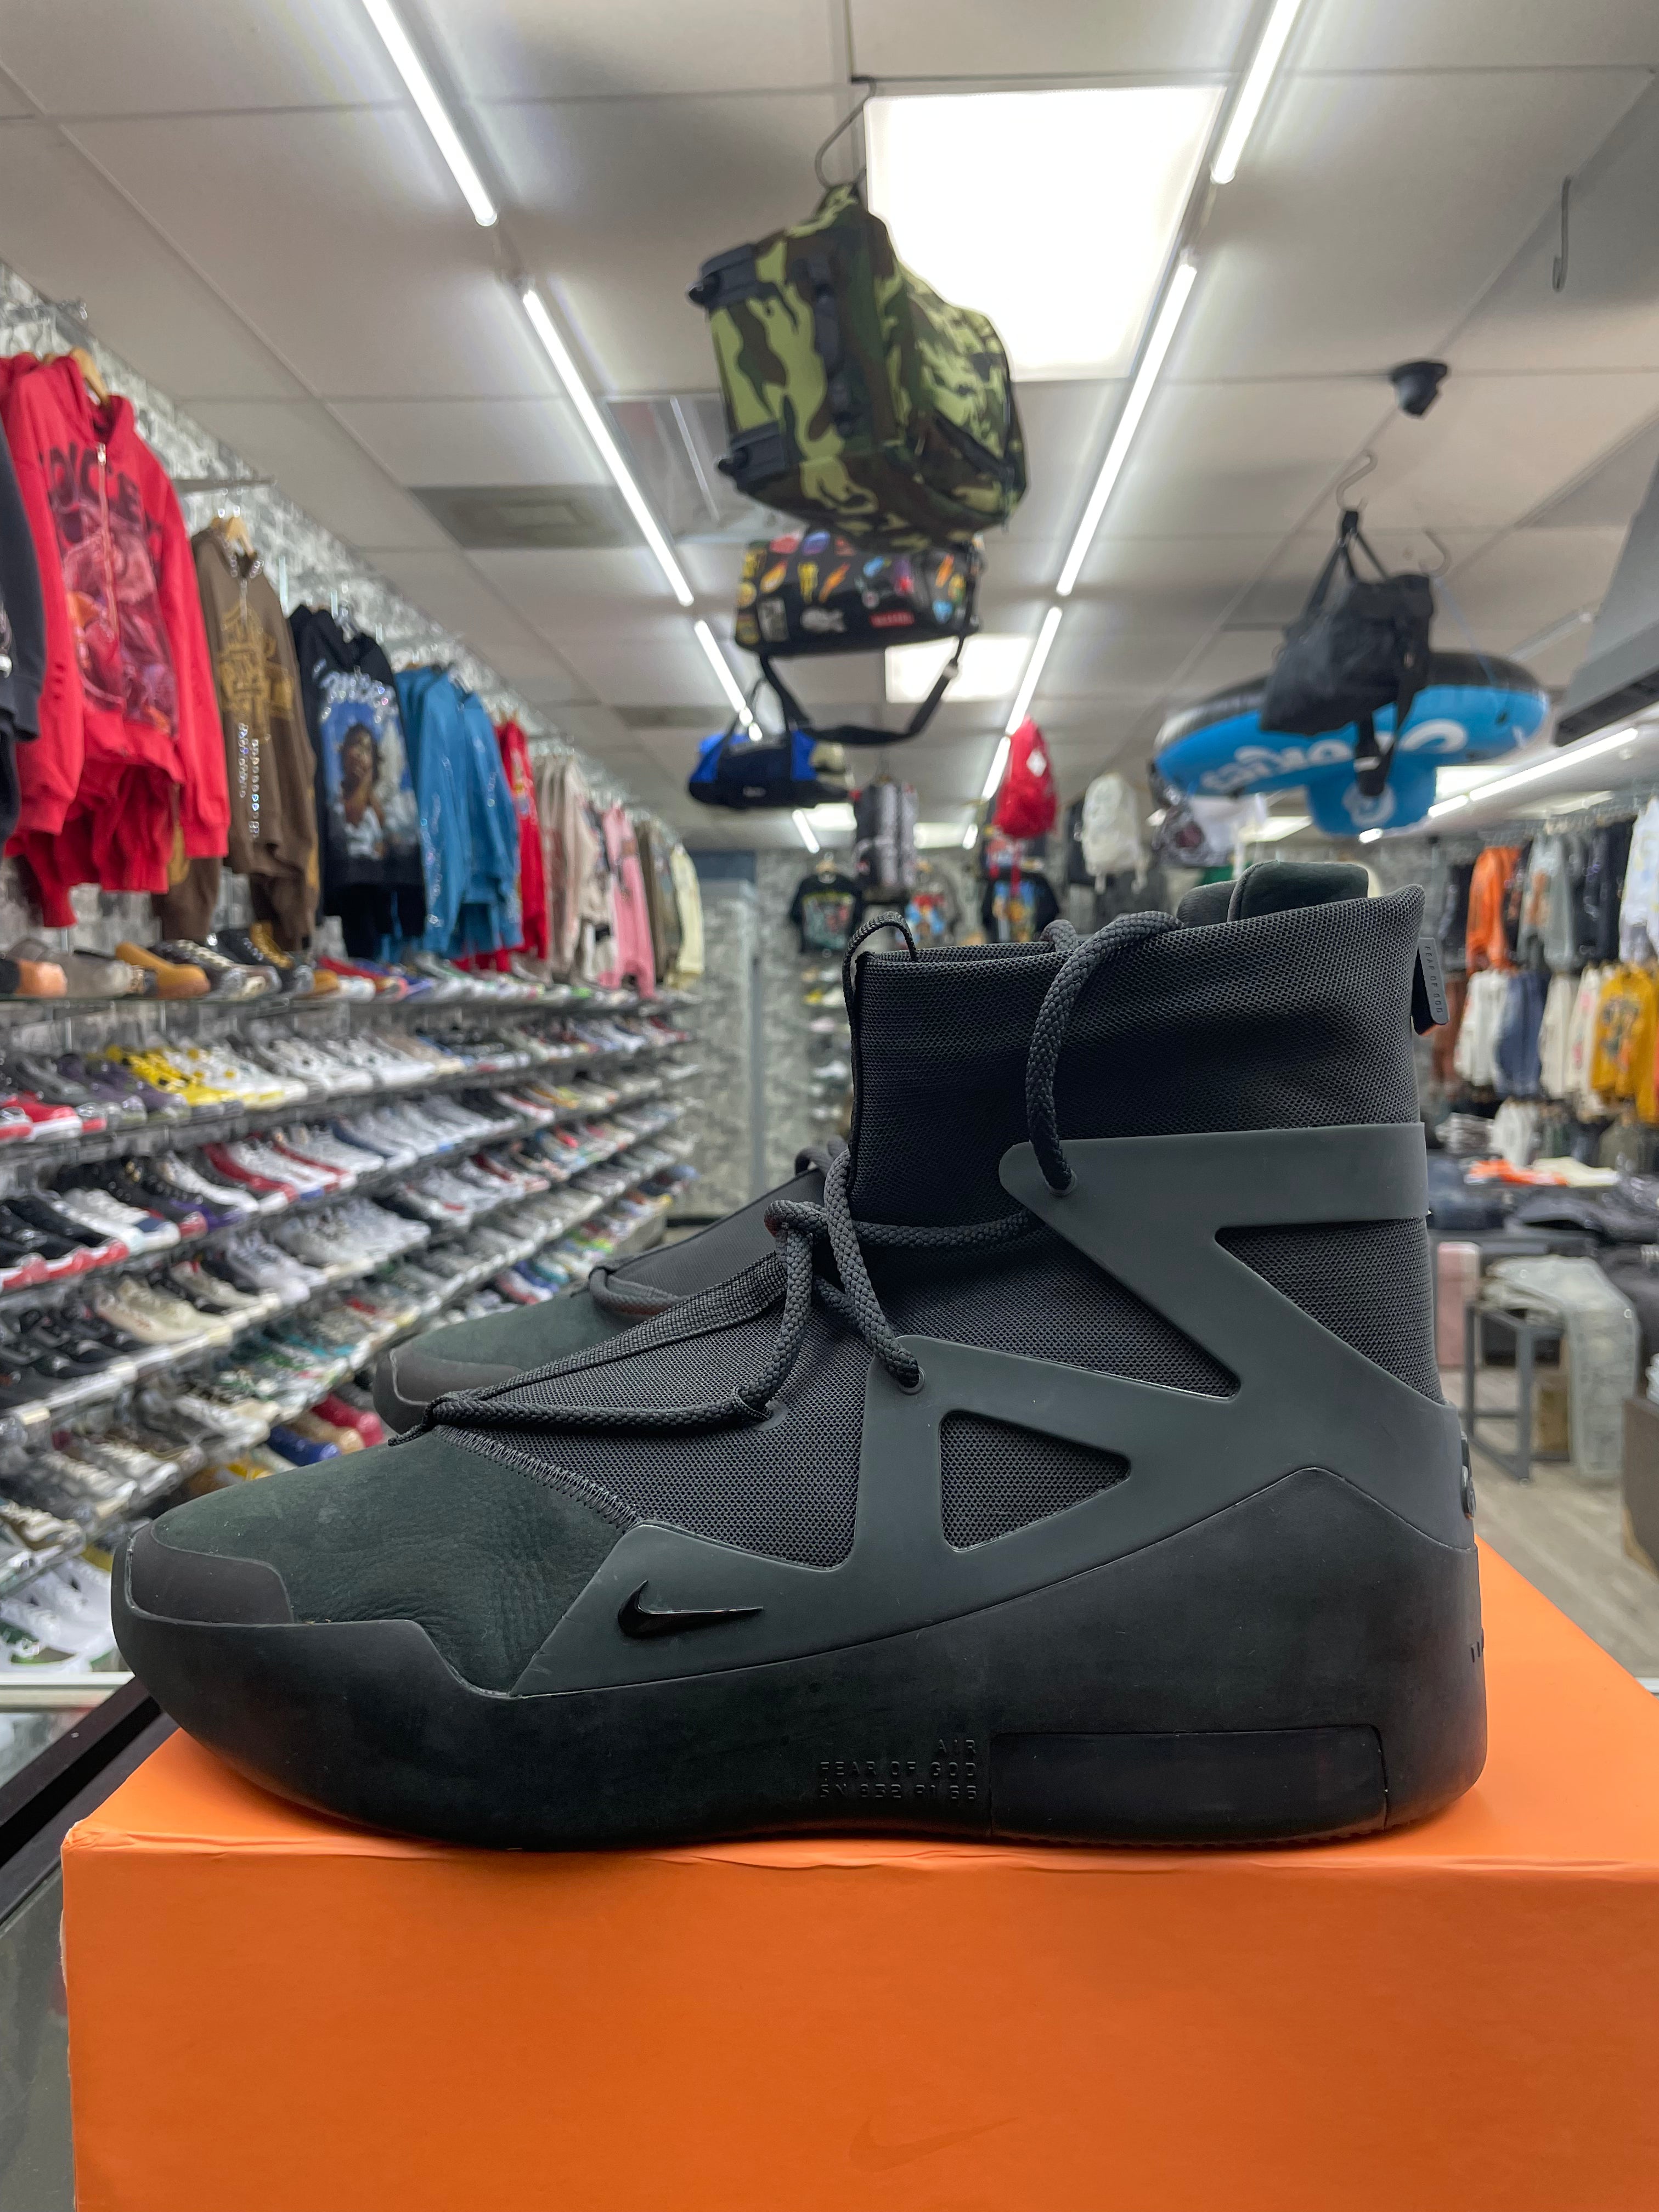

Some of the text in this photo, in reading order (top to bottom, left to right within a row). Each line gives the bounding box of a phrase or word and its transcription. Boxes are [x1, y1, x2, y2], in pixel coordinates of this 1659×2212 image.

[1430, 975, 1438, 987] OF
[938, 1739, 976, 1754] AIR
[820, 1760, 975, 1777] FEAR OF GOD
